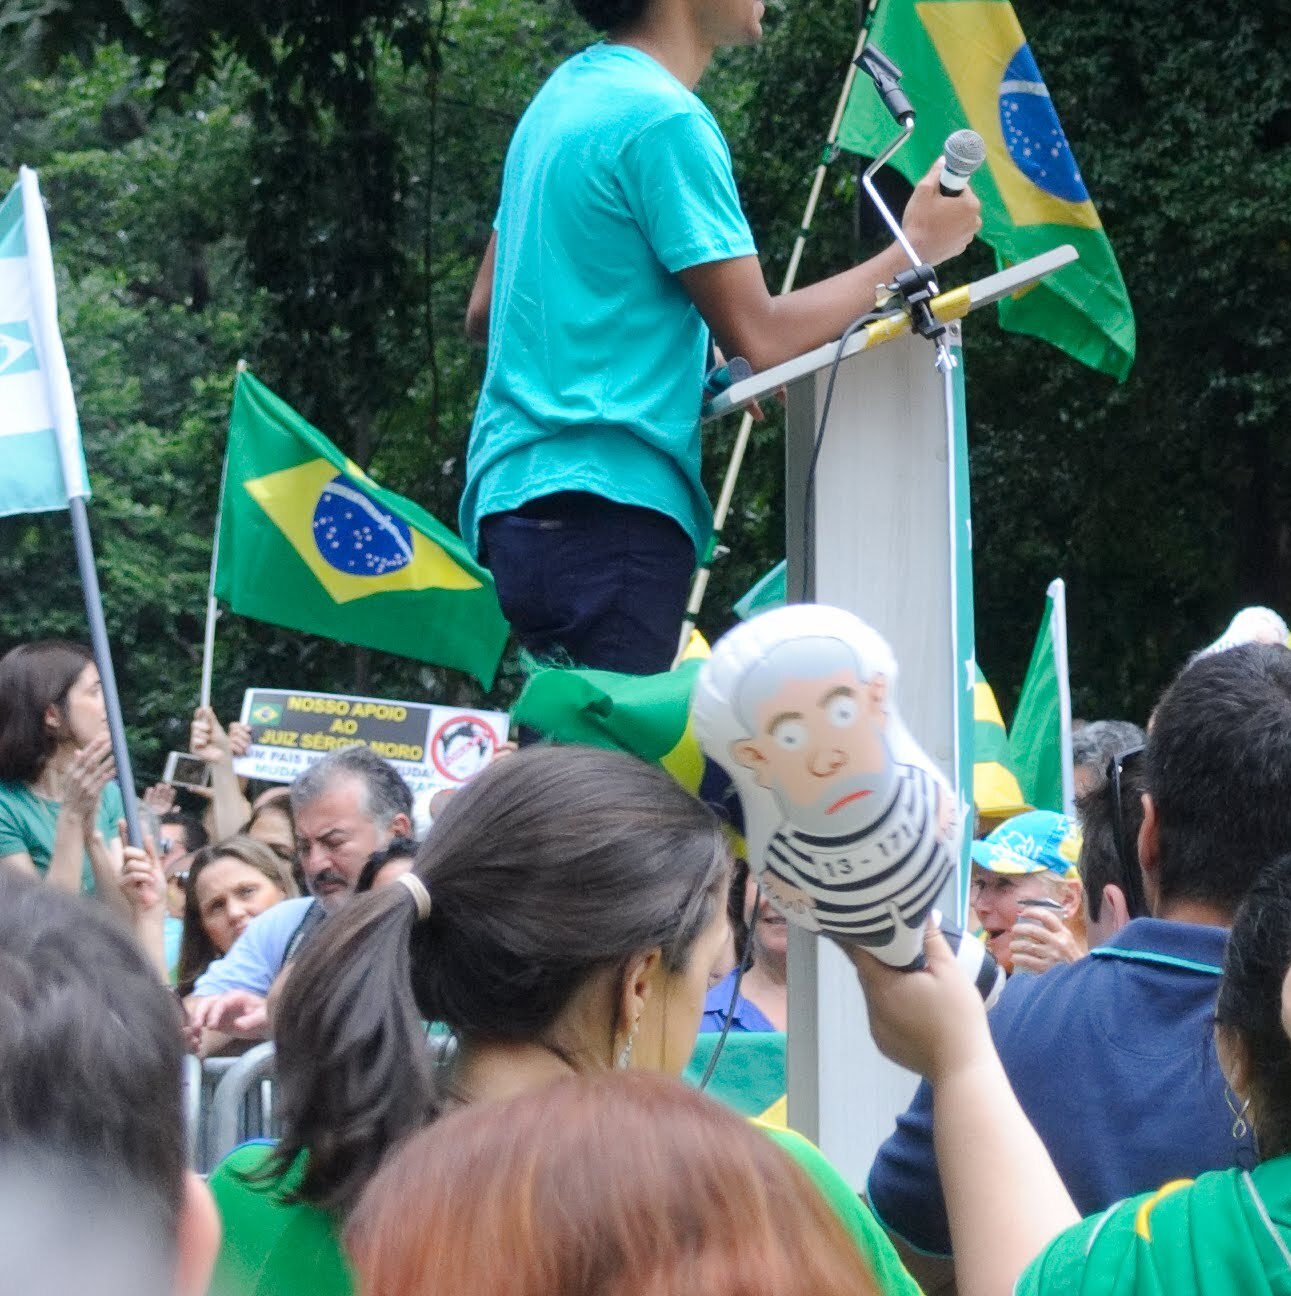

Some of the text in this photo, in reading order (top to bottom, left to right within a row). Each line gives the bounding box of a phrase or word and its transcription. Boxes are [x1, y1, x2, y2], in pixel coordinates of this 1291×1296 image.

[287, 696, 407, 722] NOSSO APOIO
[329, 718, 358, 735] AO
[258, 729, 300, 747] JUIZ
[369, 740, 423, 761] MORO
